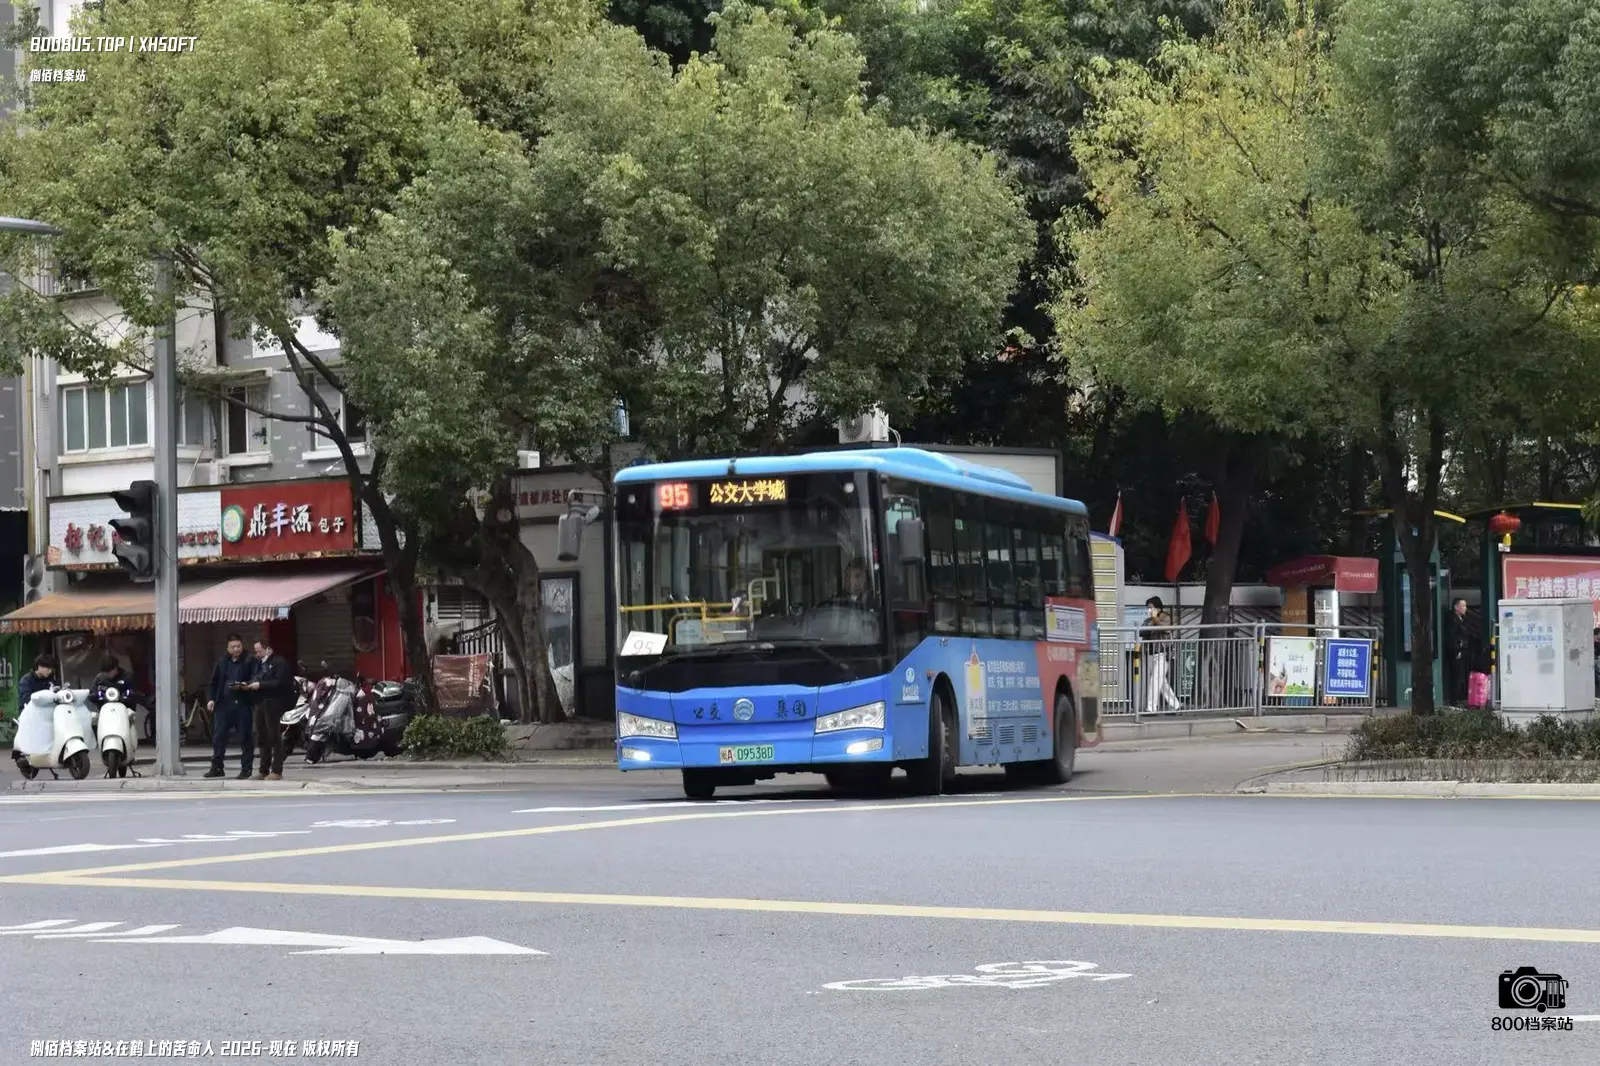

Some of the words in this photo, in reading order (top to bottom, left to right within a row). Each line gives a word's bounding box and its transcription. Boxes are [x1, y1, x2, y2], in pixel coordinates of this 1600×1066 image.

[660, 484, 690, 506] 95
[709, 479, 786, 503] 公交大学城
[318, 516, 345, 533] 包子
[632, 639, 655, 656] 95
